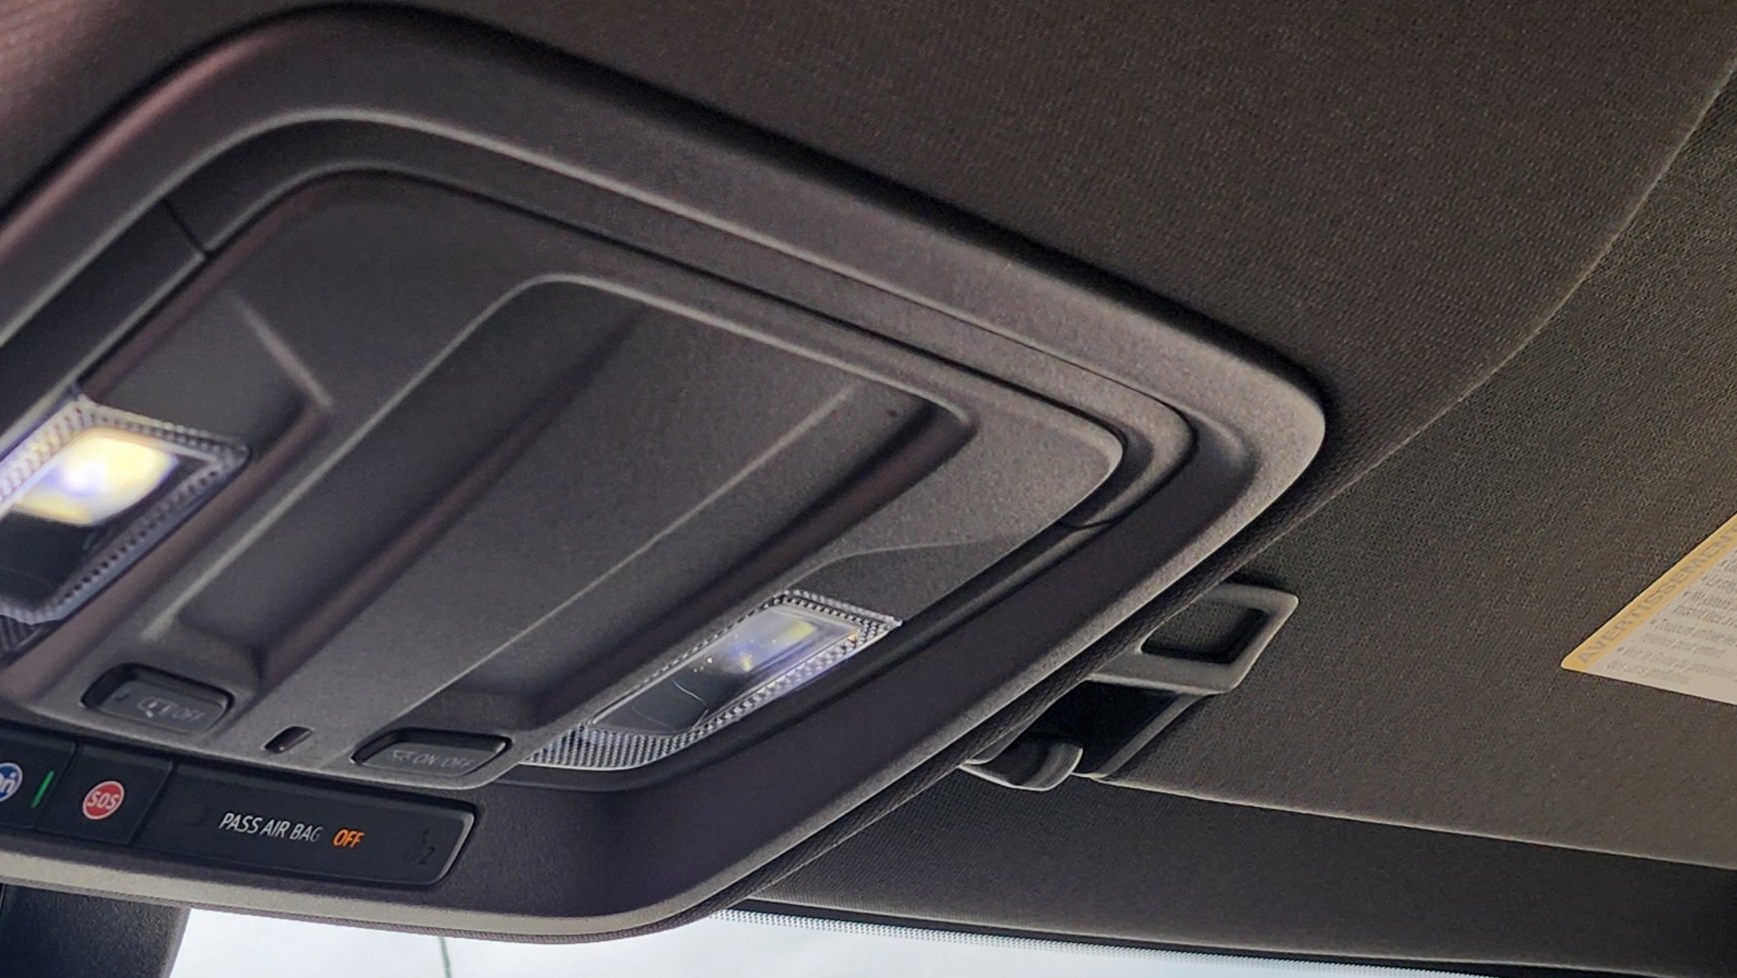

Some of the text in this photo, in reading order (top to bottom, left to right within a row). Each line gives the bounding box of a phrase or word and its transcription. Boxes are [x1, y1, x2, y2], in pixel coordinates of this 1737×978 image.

[85, 790, 120, 810] SOS
[219, 812, 365, 848] PASS AIR BAG OFF
